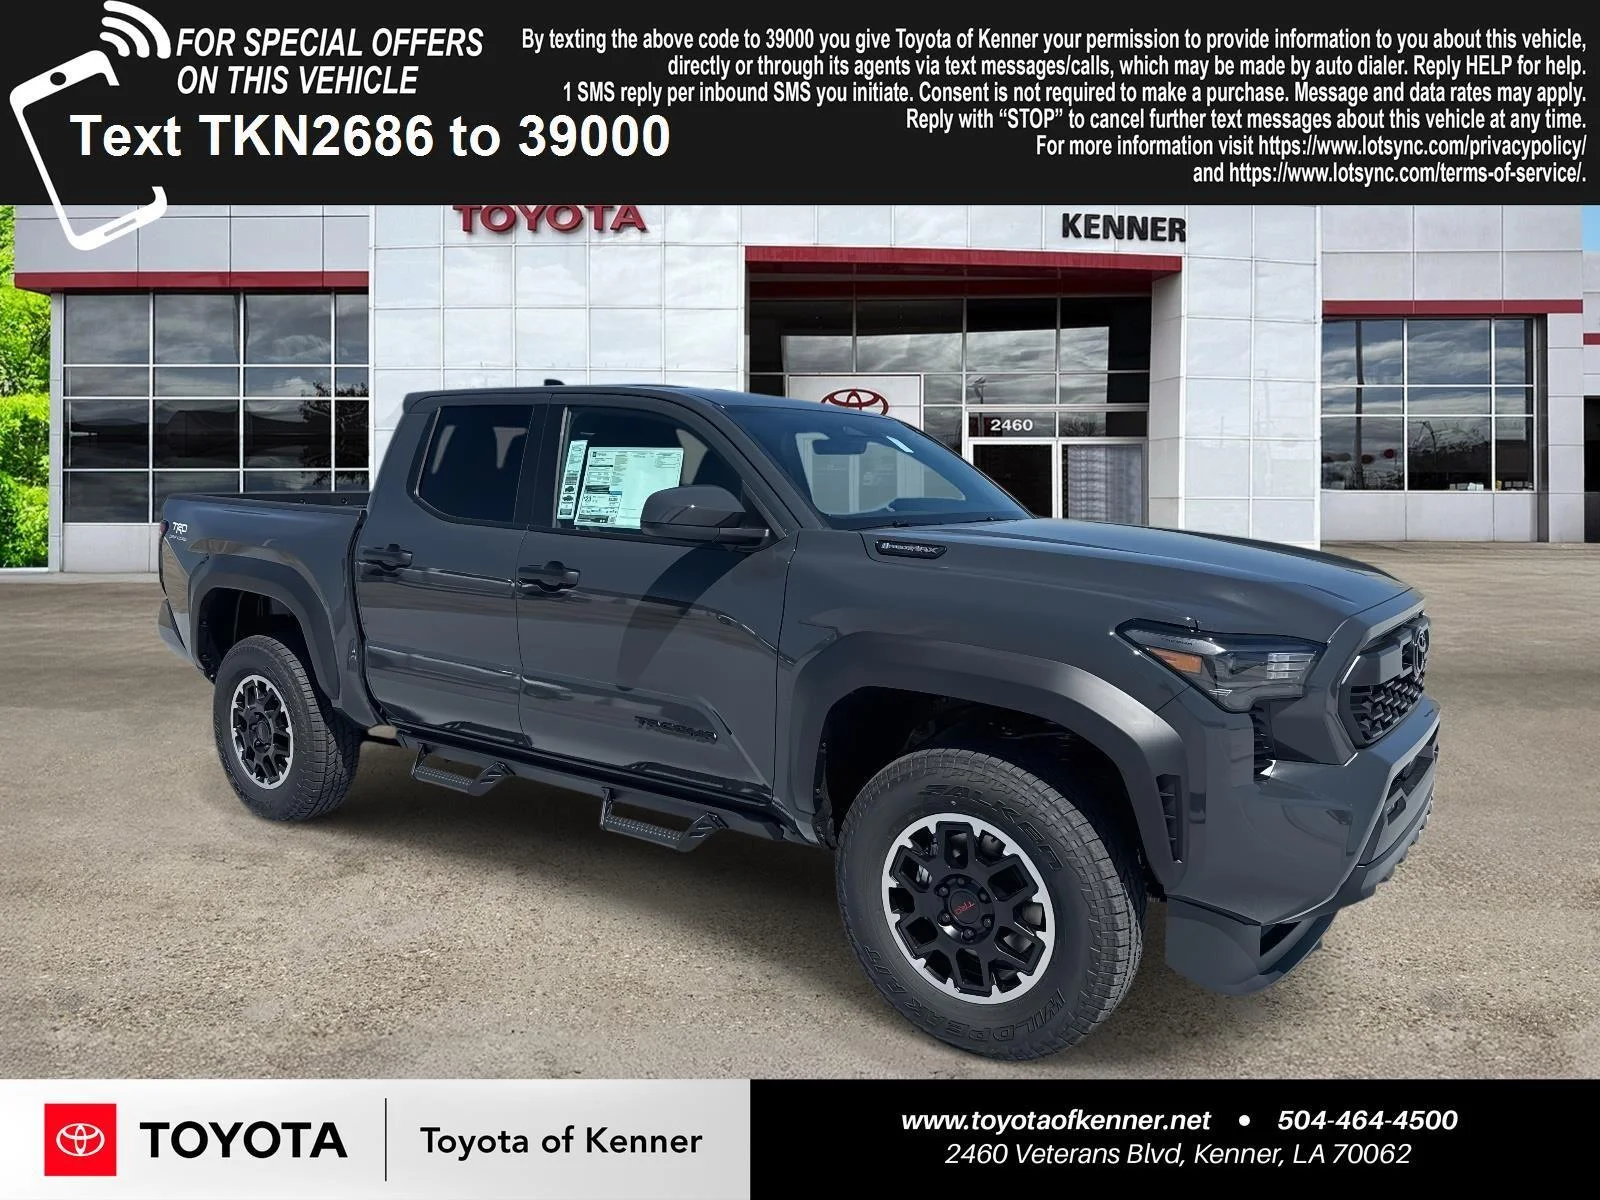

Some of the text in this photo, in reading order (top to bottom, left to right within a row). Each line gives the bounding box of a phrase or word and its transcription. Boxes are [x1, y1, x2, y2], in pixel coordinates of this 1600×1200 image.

[452, 205, 647, 232] TOYOTA
[1062, 213, 1186, 242] KENNER
[990, 419, 1033, 431] 2460
